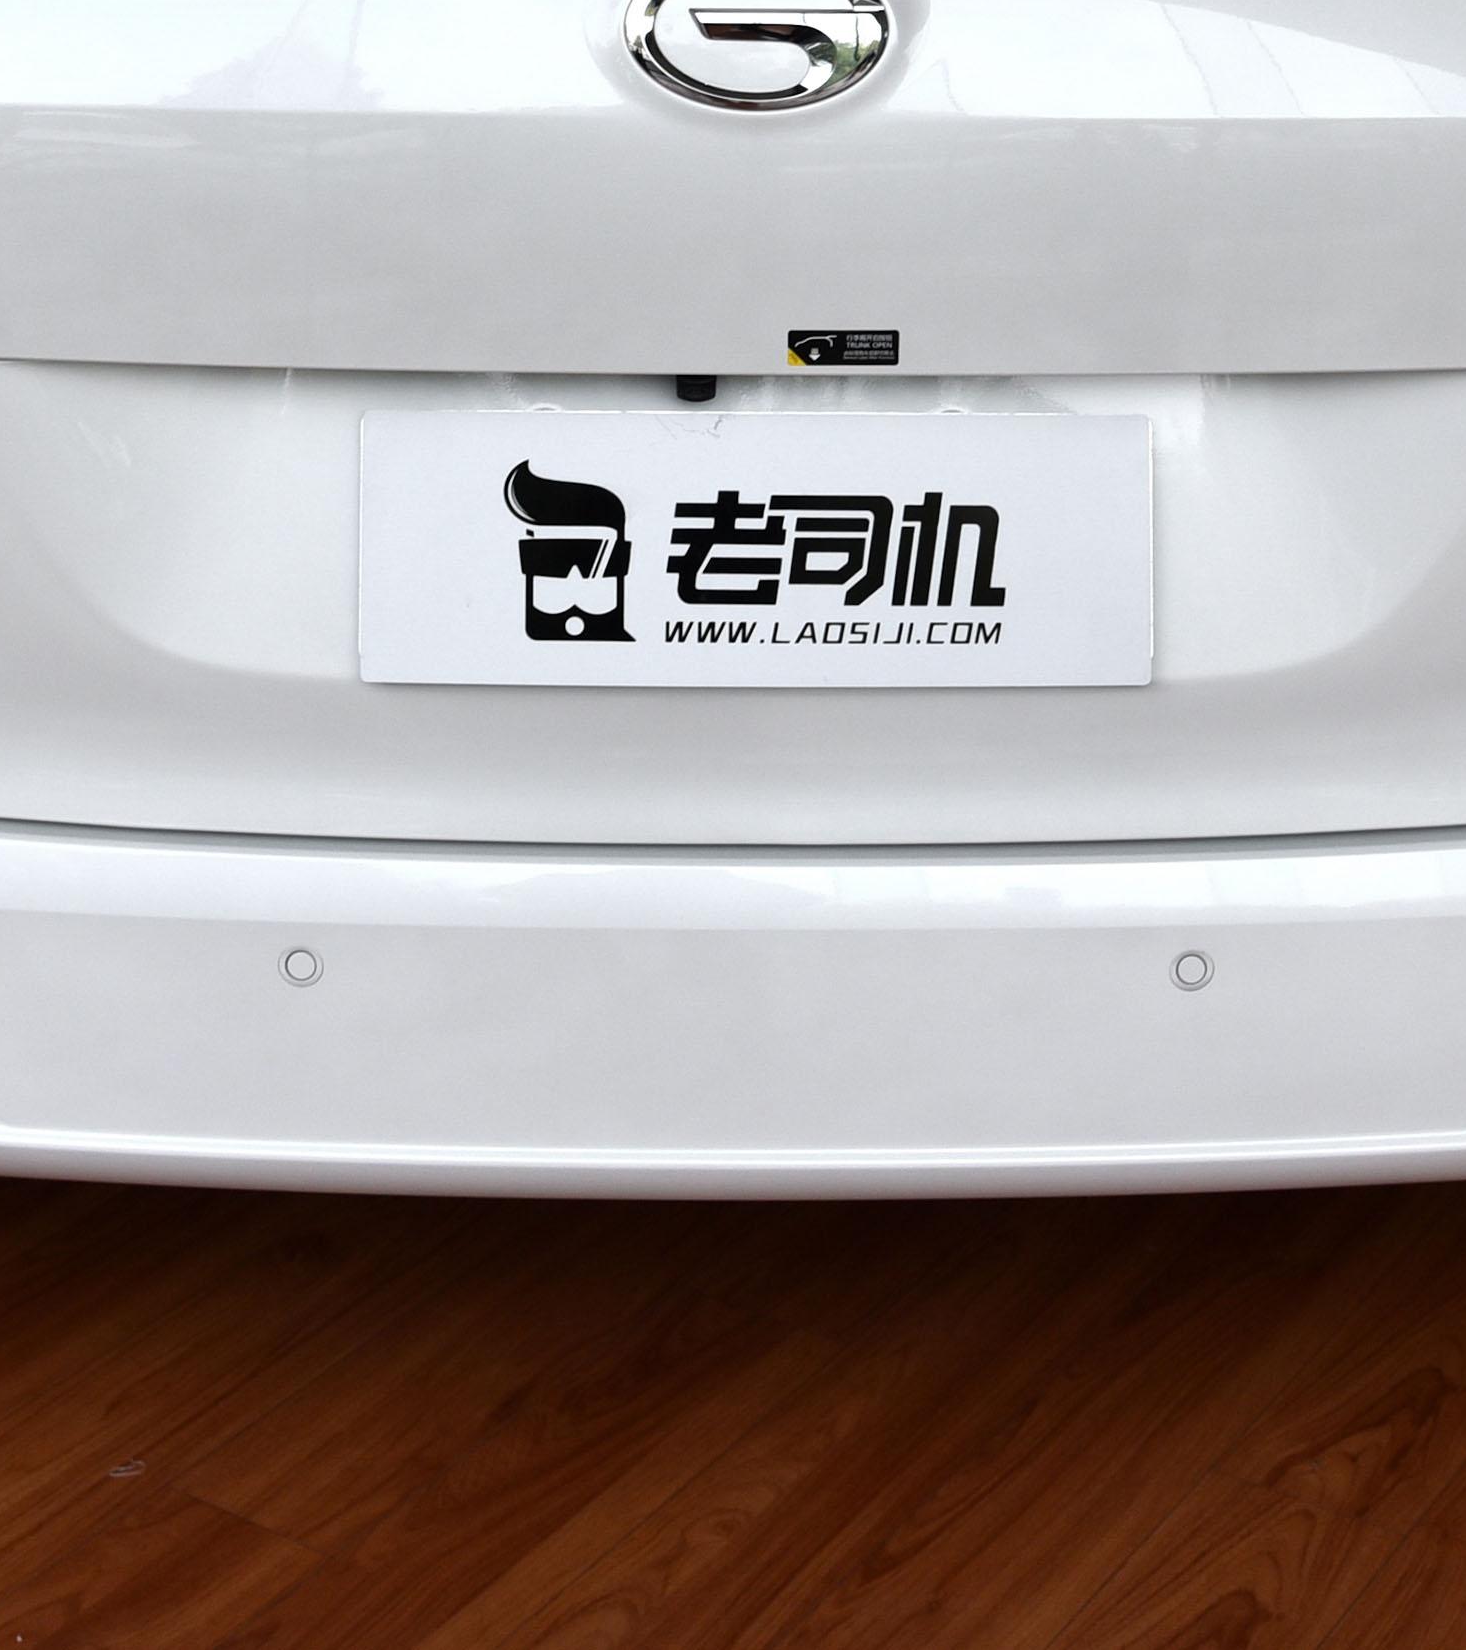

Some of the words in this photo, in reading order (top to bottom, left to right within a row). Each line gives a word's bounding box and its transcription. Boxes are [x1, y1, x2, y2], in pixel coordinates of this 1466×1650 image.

[846, 341, 871, 349] TRUNK
[872, 341, 893, 349] OPEN
[665, 490, 1007, 607] 老司机
[664, 620, 1003, 645] WWW.LAOSIJI.COM
